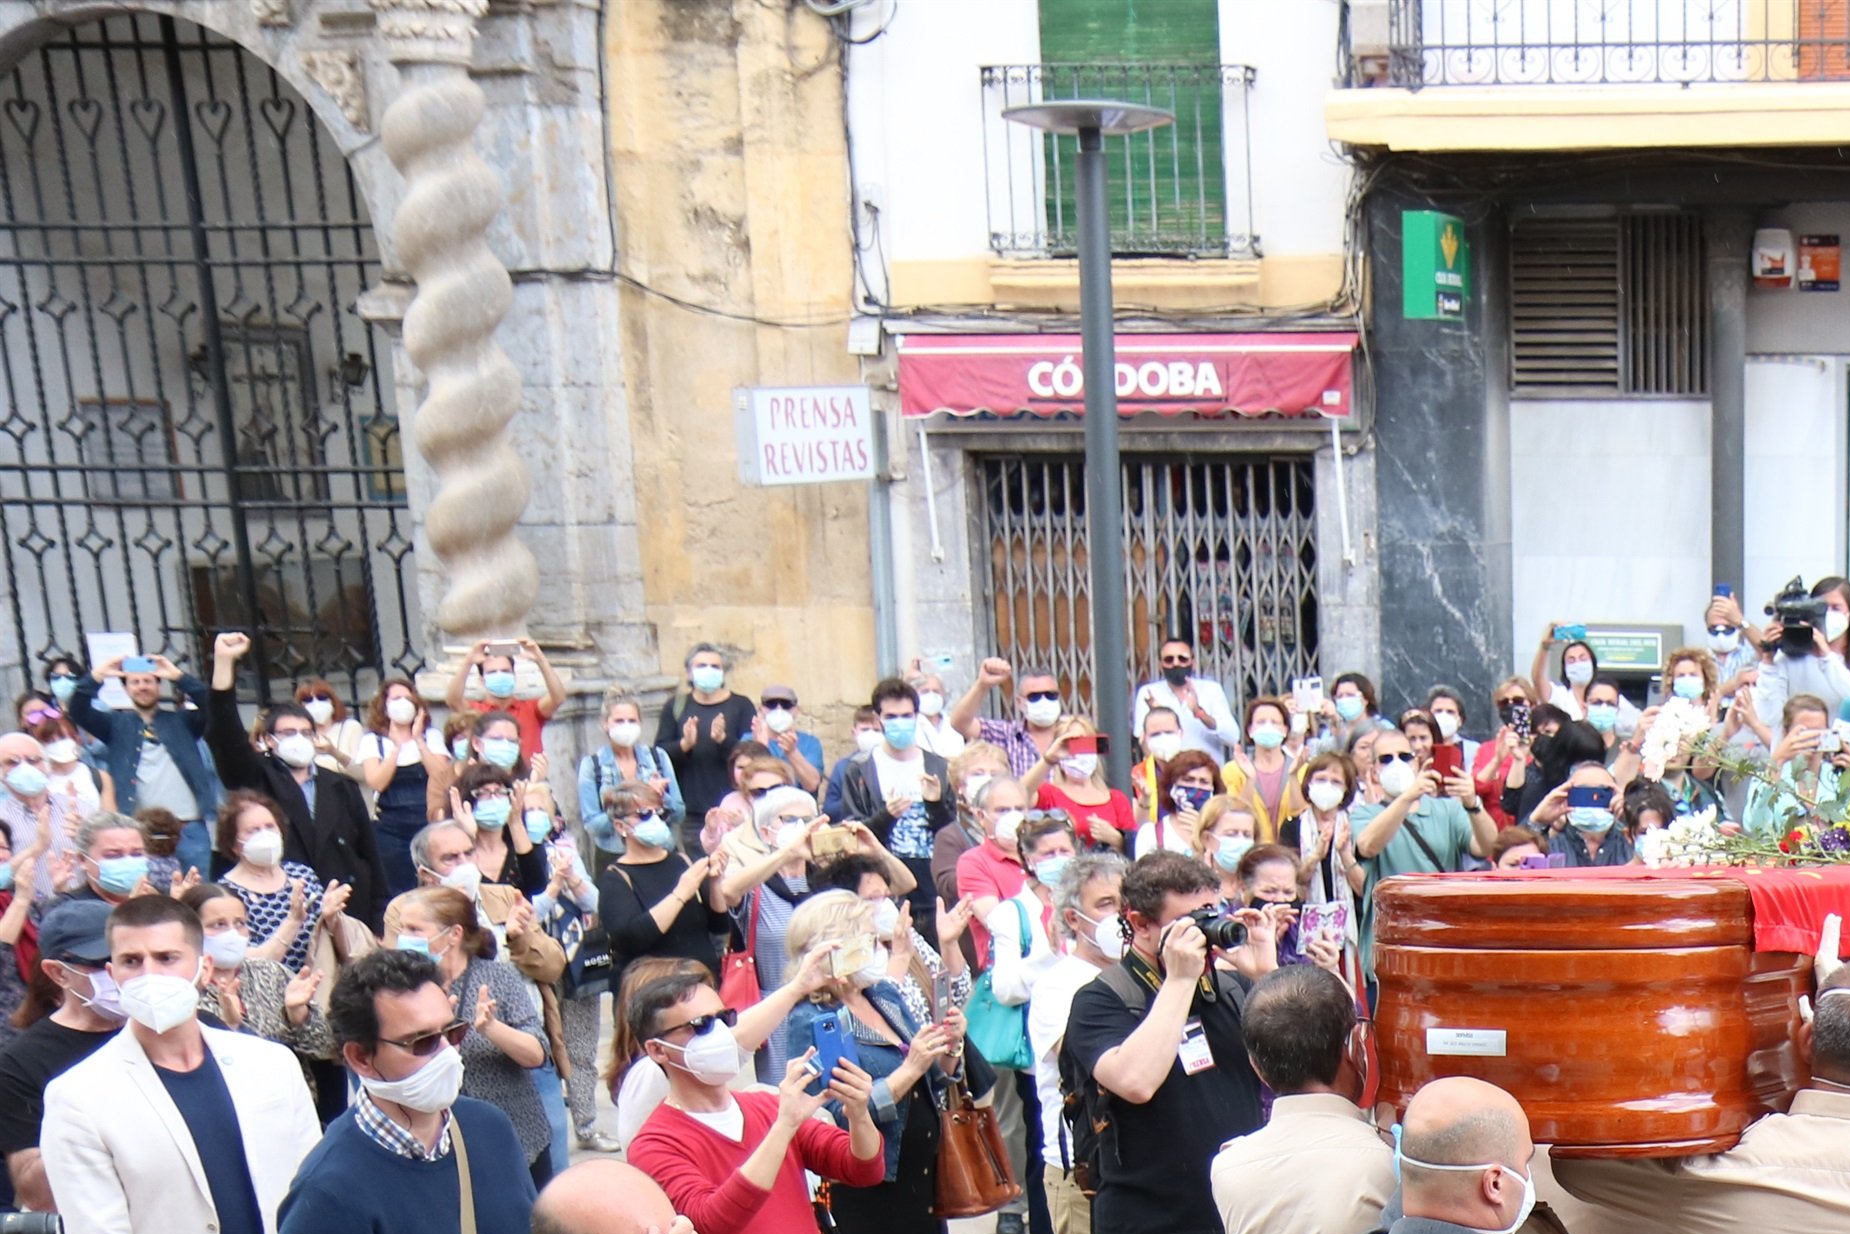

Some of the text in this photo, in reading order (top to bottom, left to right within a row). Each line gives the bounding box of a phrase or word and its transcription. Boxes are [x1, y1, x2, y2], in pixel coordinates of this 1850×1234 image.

[1027, 355, 1223, 397] CÓDOBA
[769, 395, 857, 431] PRENSA
[763, 438, 869, 477] REVISTAS
